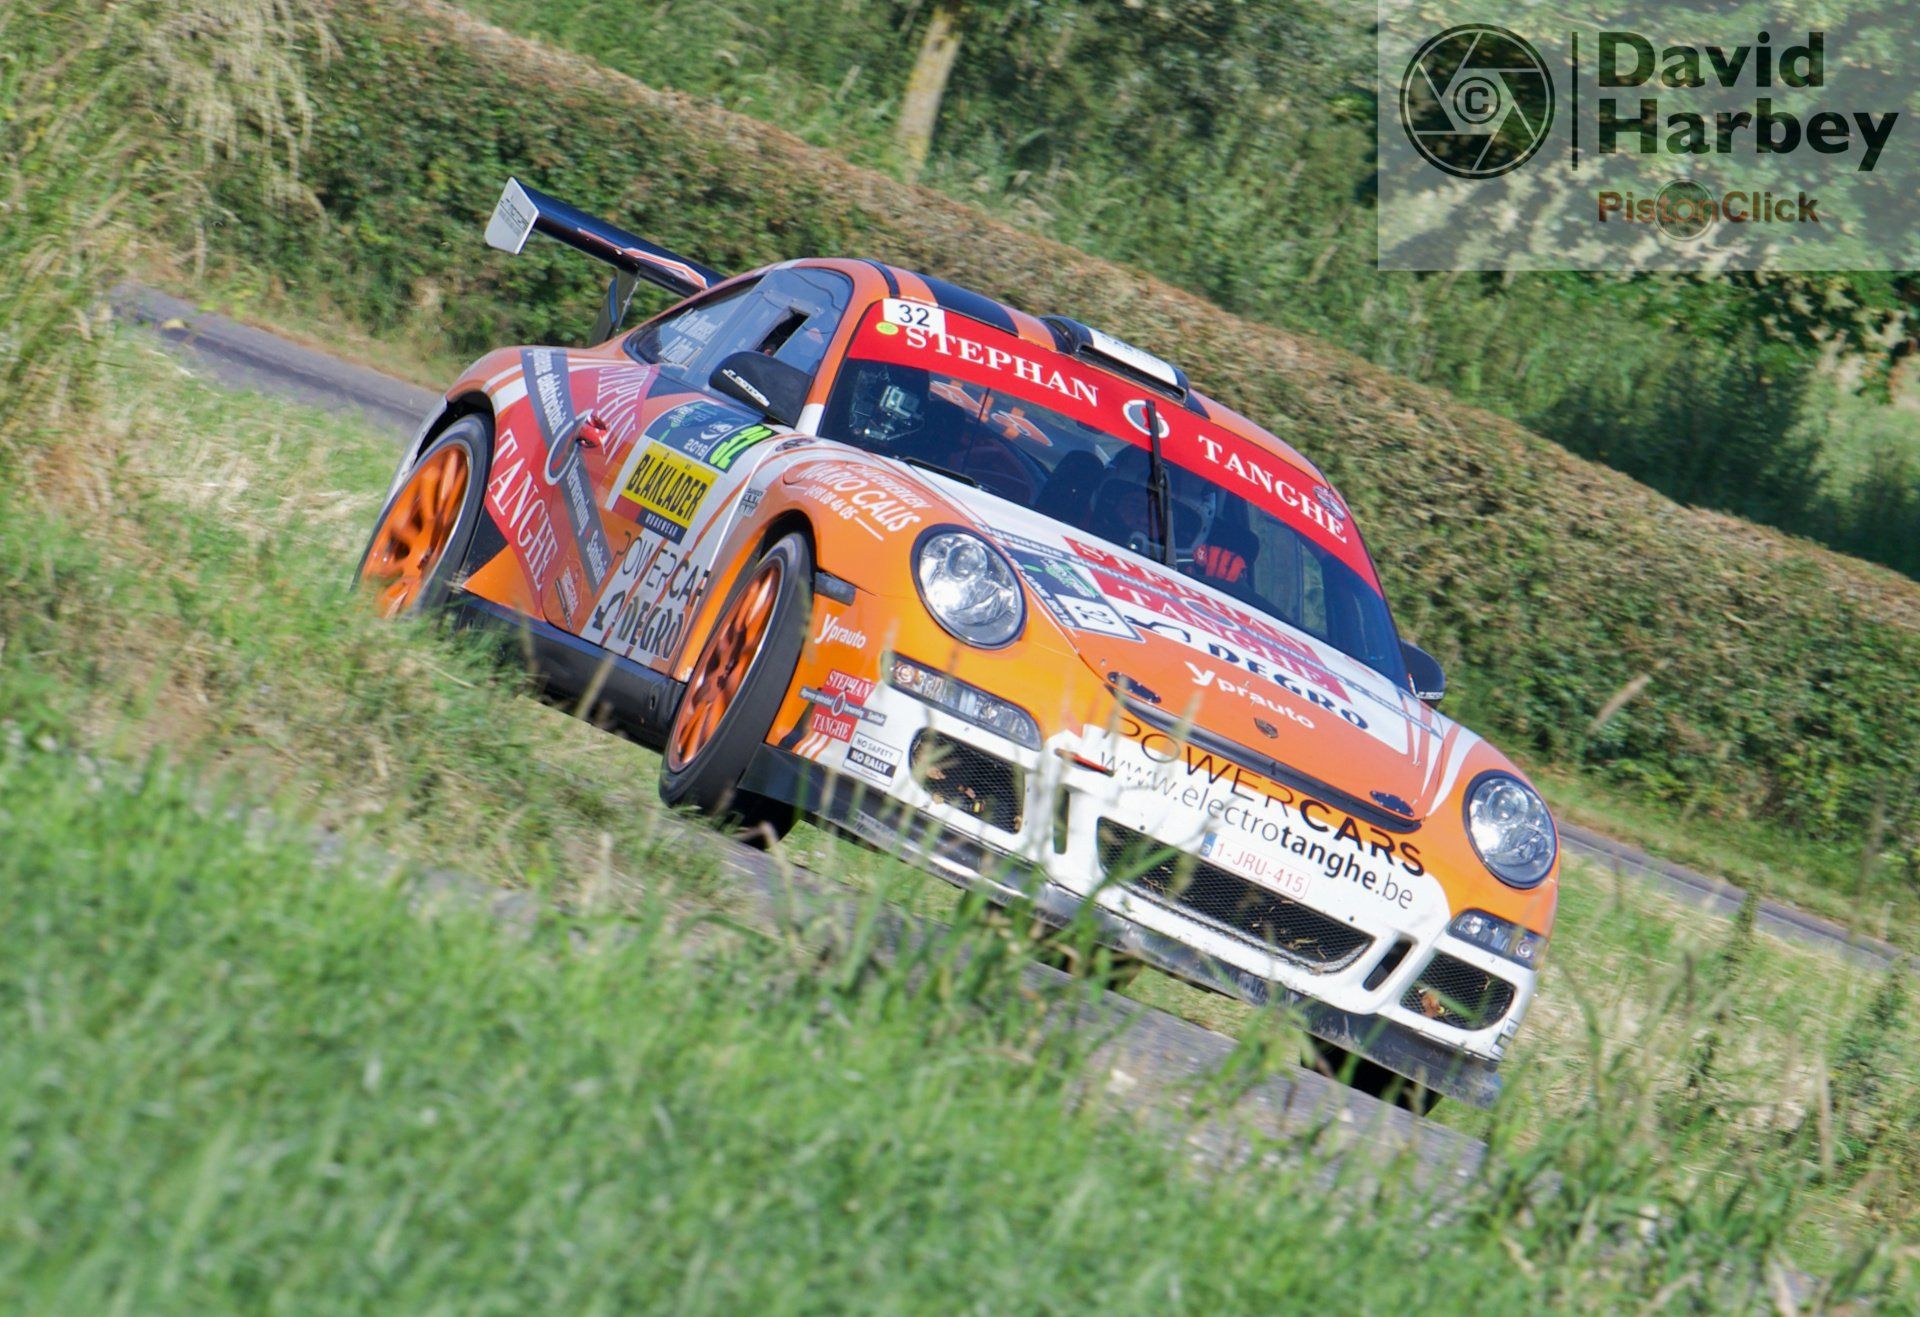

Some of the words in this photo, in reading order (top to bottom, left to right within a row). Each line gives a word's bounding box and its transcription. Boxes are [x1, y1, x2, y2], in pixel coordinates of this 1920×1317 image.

[899, 303, 930, 328] 32
[905, 325, 1100, 408] STEPHAN
[1198, 434, 1348, 544] TANGHE
[488, 428, 558, 592] TANGHE
[851, 490, 921, 532] CALIS
[617, 596, 685, 659] DEGRO
[1077, 541, 1309, 653] STEPHAN
[1117, 584, 1330, 690] TANGHE
[1208, 642, 1369, 730] DEGRO
[813, 713, 852, 741] TANGHE
[851, 749, 866, 763] NO
[864, 755, 890, 774] RALLY
[856, 737, 868, 749] NO
[868, 741, 894, 759] SAFETY
[1101, 751, 1413, 910] www.electrotanghe.be
[1103, 716, 1425, 877] POWERCARS
[1217, 842, 1304, 893] 1-JRU-415
